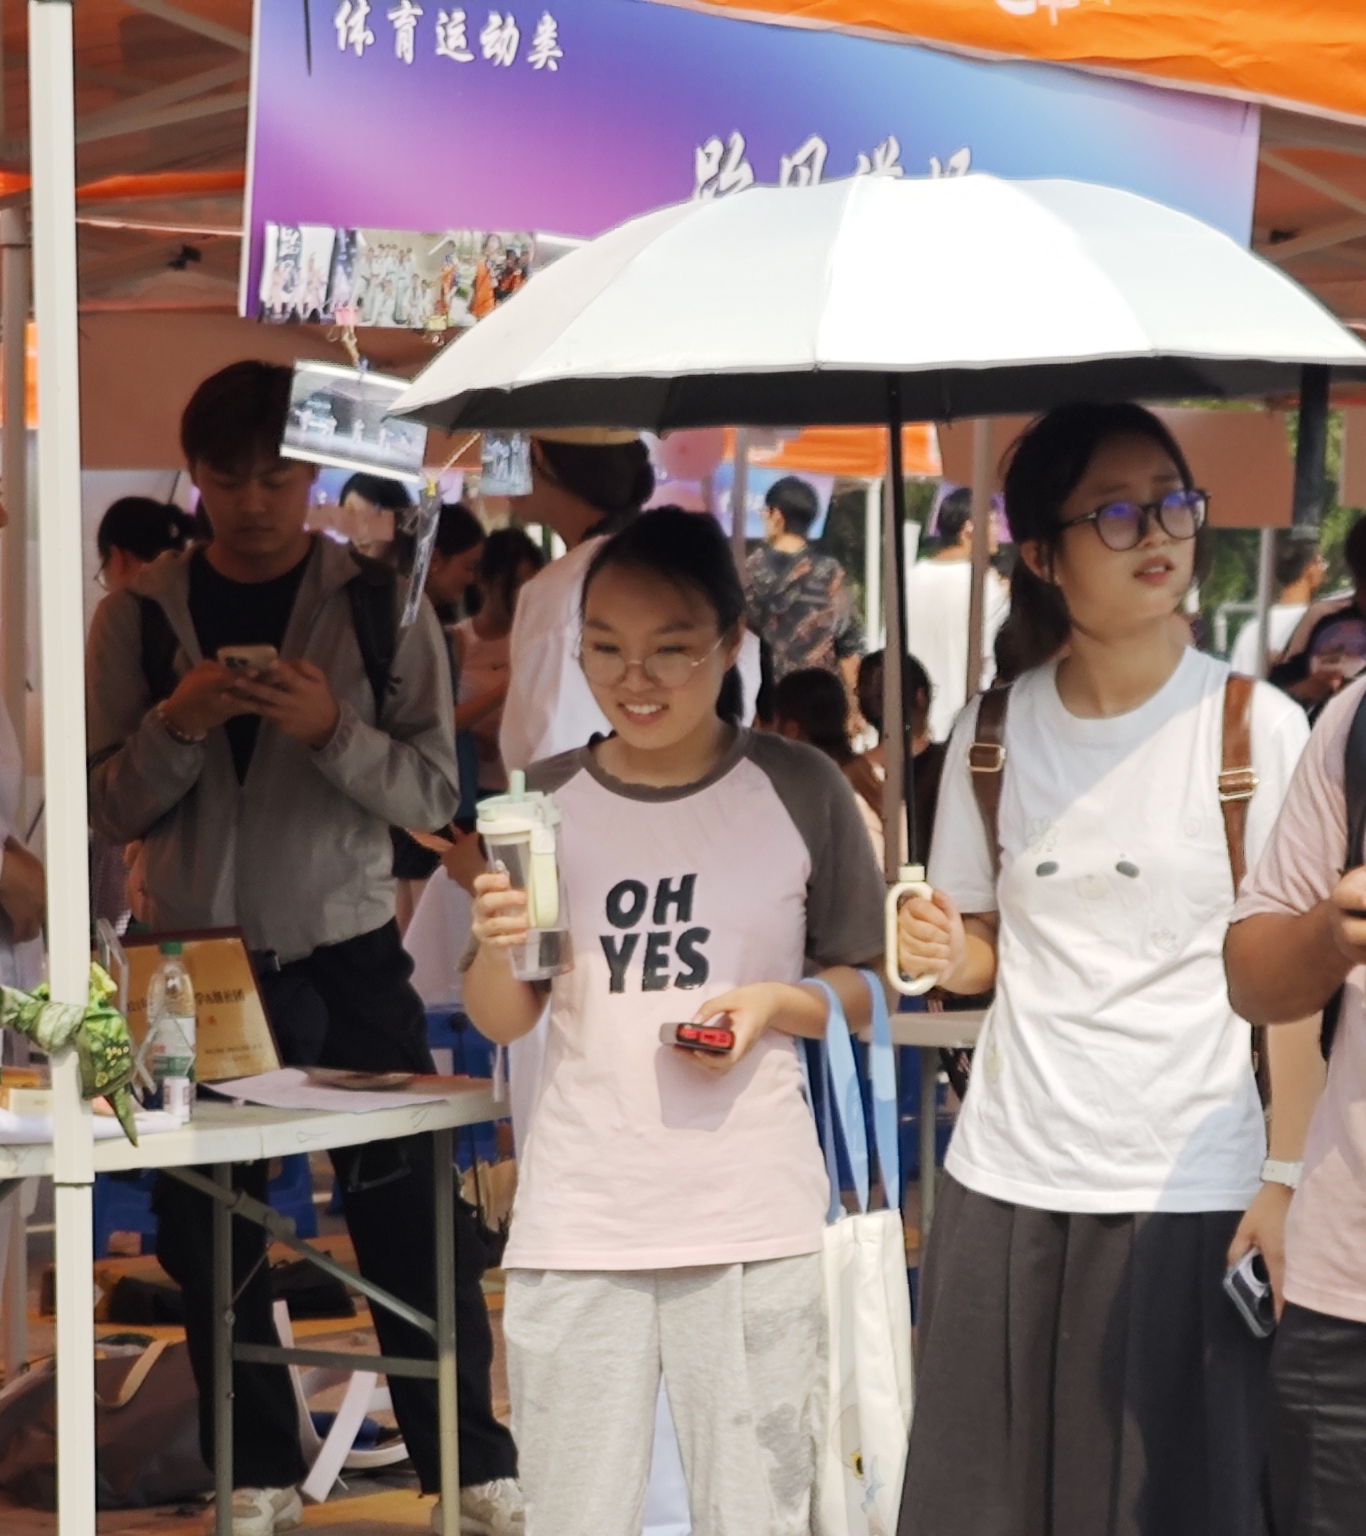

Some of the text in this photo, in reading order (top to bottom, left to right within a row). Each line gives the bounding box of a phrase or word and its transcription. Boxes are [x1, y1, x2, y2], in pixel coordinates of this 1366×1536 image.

[332, 0, 565, 72] 体育运动类
[605, 874, 698, 929] OH
[600, 927, 712, 994] YES
